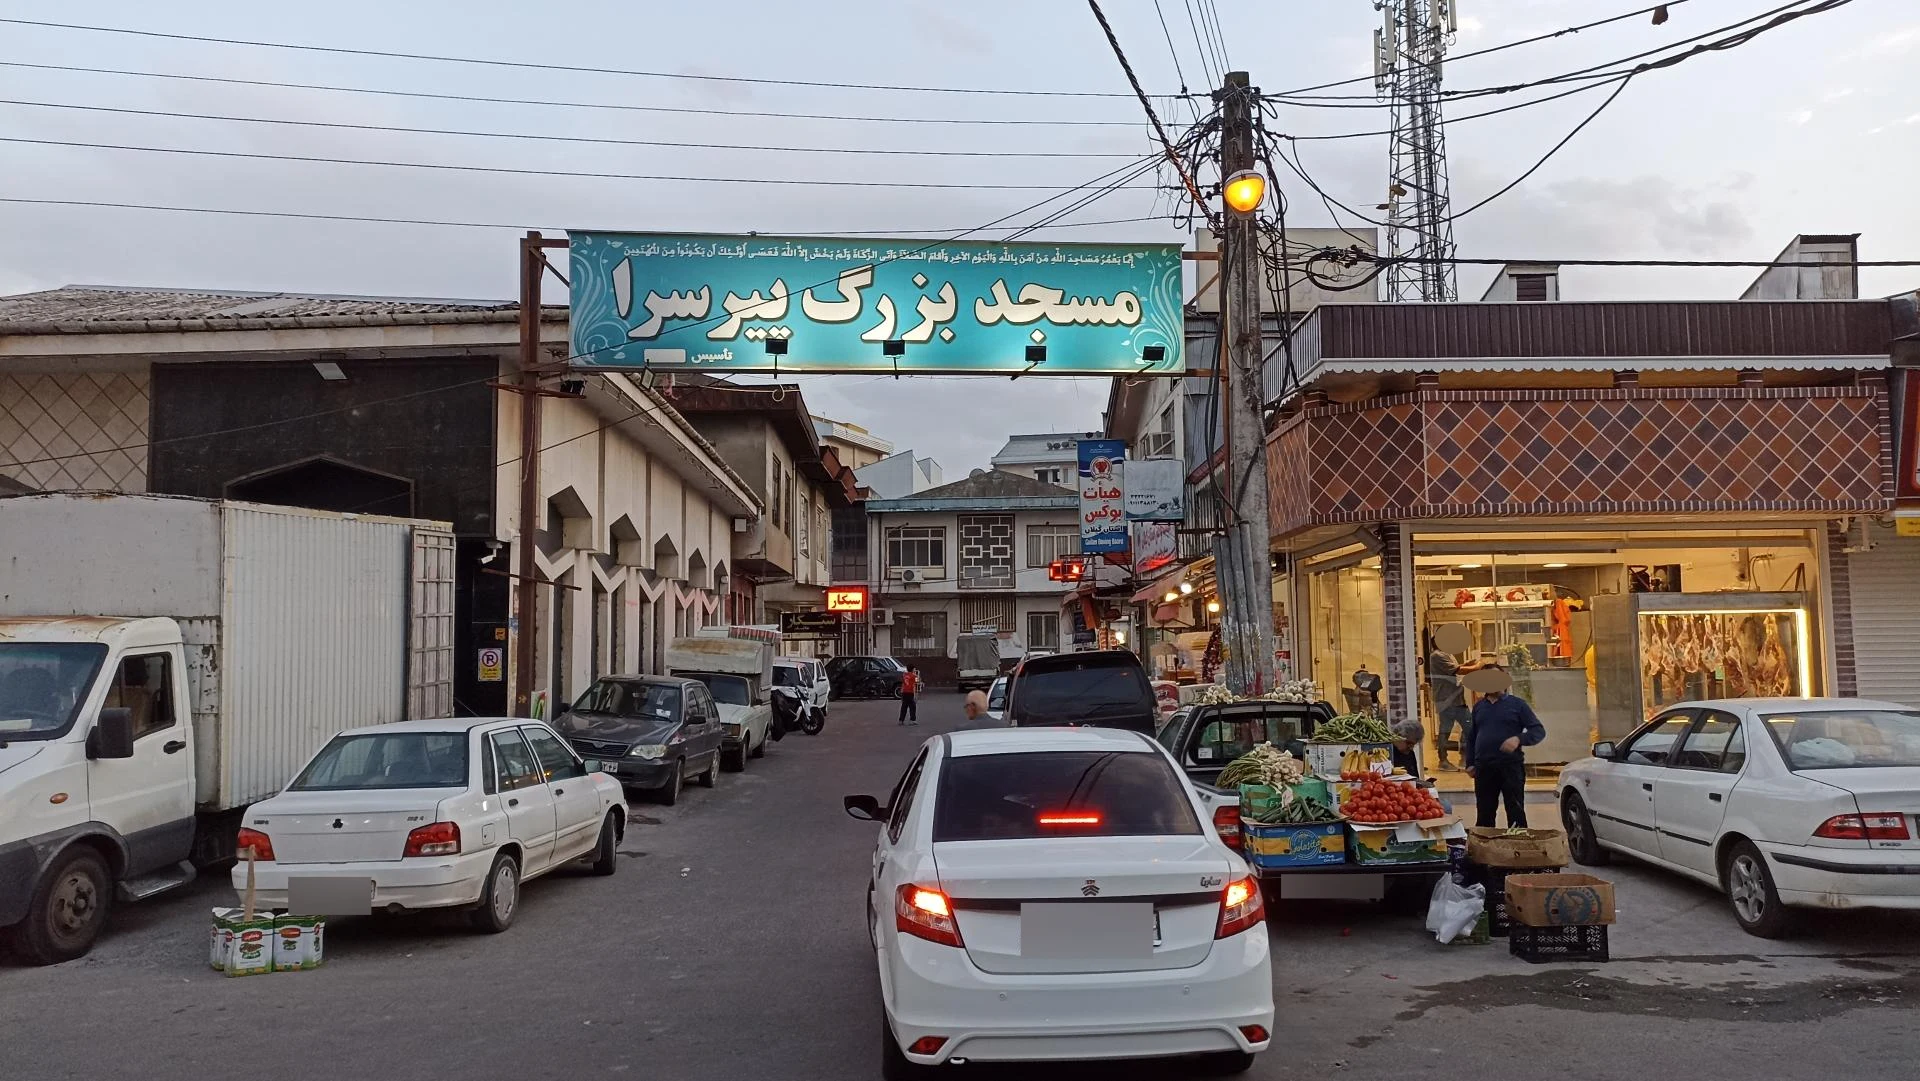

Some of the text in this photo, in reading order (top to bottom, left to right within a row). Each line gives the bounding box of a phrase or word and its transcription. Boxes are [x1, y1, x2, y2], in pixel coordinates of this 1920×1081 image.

[801, 264, 958, 344] بزرگ
[974, 278, 1142, 345] مسجد
[691, 347, 733, 364] تأسیس
[1084, 505, 1122, 524] بوکس
